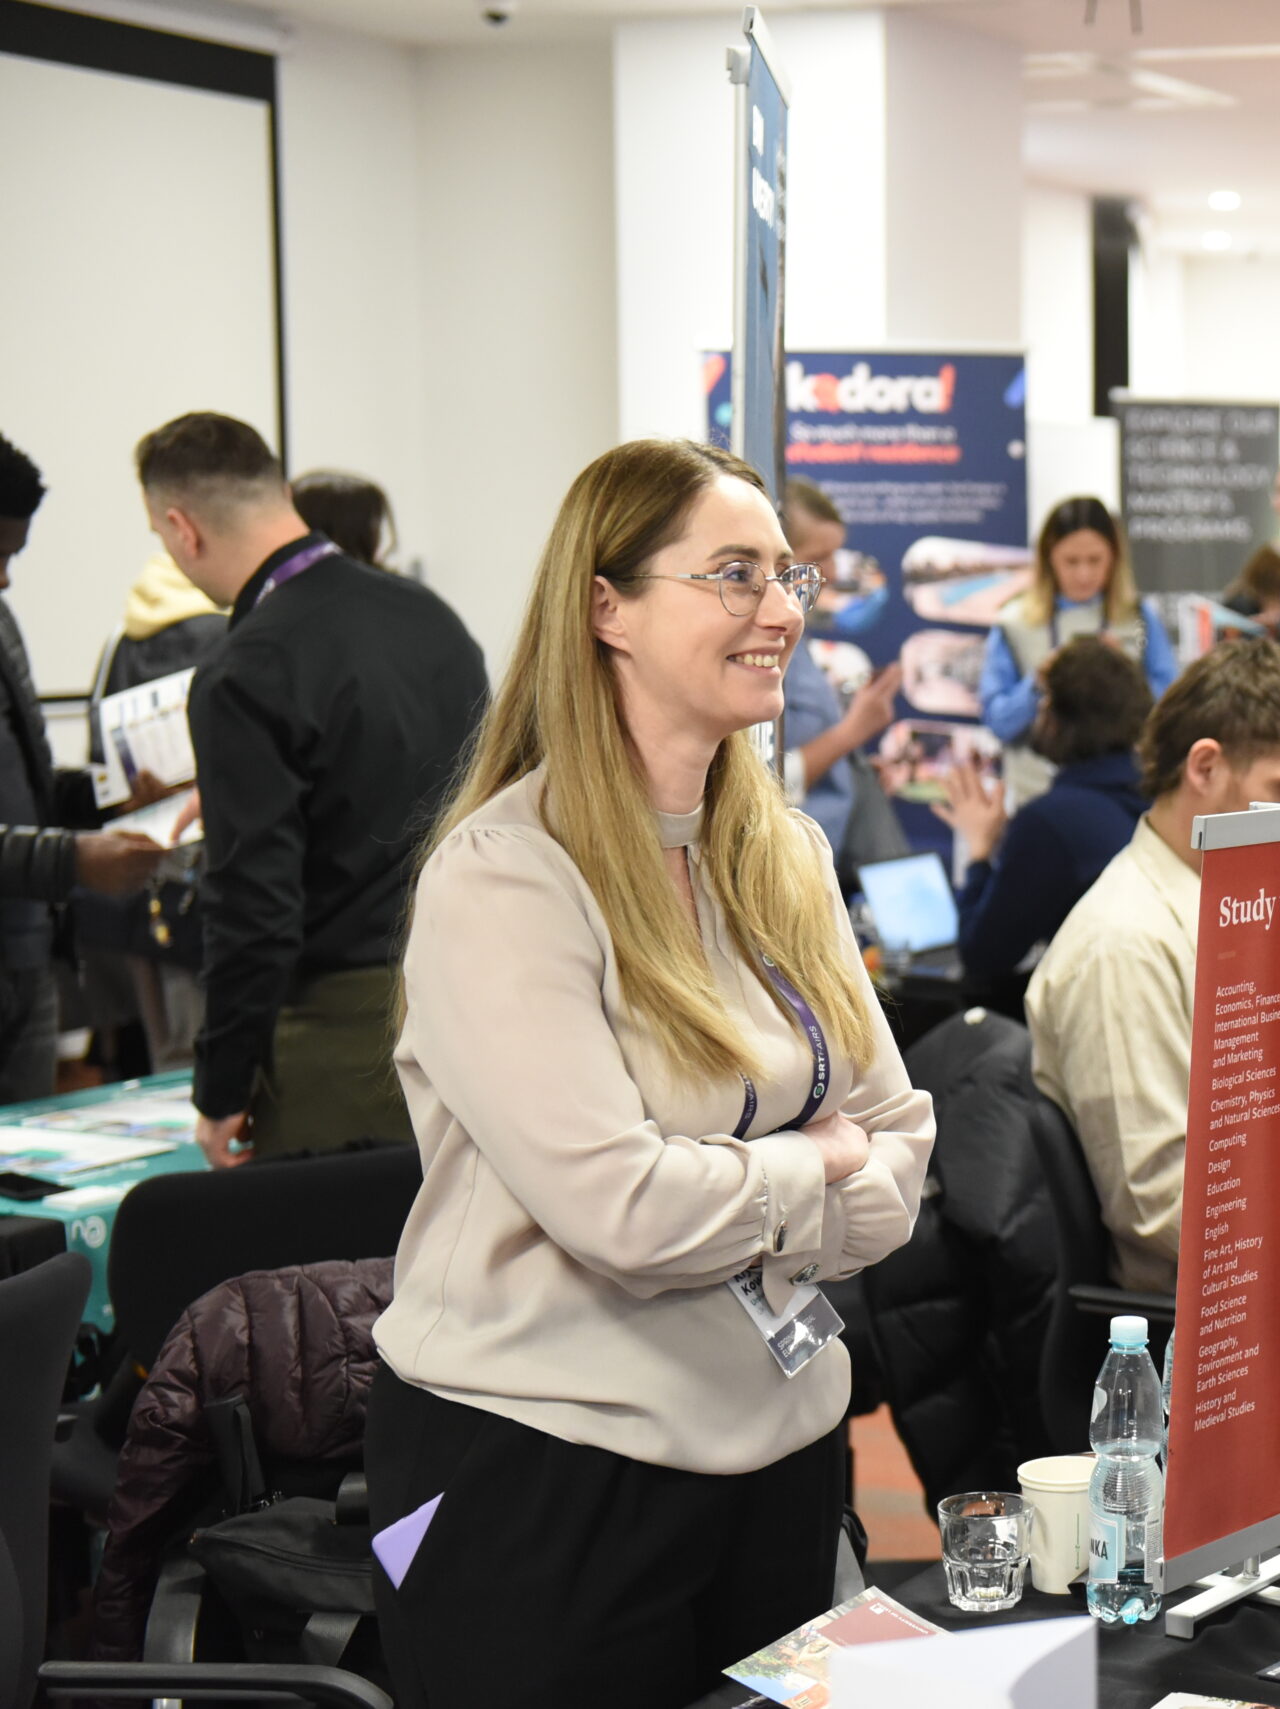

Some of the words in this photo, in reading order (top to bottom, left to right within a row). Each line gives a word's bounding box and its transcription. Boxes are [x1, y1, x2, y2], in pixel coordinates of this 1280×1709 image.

[1220, 887, 1277, 931] Study
[1216, 979, 1256, 998] Accounting,
[1216, 999, 1254, 1016] Economics,
[1215, 1012, 1259, 1033] International
[1214, 1031, 1259, 1051] Management
[1213, 1054, 1226, 1069] and
[1227, 1046, 1264, 1065] Marketing
[1212, 1070, 1245, 1091] Biological
[1246, 1066, 1276, 1082] Sciences
[1211, 1095, 1247, 1112] Chemistry,
[1249, 1087, 1275, 1104] Physics
[1210, 1115, 1223, 1130] and
[1224, 1108, 1251, 1126] Natural
[1252, 1103, 1280, 1119] Sciences
[1209, 1132, 1247, 1152] Computing
[1208, 1158, 1231, 1174] Design
[1207, 1176, 1241, 1196] Education
[1206, 1196, 1248, 1219] Engineering
[1205, 1221, 1229, 1241] English
[1204, 1248, 1219, 1262] Fine
[1220, 1243, 1233, 1256] Art,
[1235, 1236, 1263, 1251] History
[1203, 1264, 1211, 1279] of
[1212, 1263, 1223, 1276] Art
[1225, 1256, 1238, 1272] and
[1202, 1276, 1229, 1297] Cultural
[1230, 1269, 1258, 1287] Studies
[1201, 1300, 1219, 1318] Food
[1220, 1294, 1247, 1312] Science
[1200, 1320, 1213, 1336] and
[1214, 1311, 1247, 1331] Nutrition
[1199, 1335, 1239, 1358] Geography,
[1198, 1350, 1243, 1375] Environment
[1244, 1342, 1260, 1359] and
[1197, 1375, 1216, 1393] Earth
[1218, 1365, 1249, 1385] Sciences
[1196, 1396, 1222, 1414] History
[1223, 1387, 1237, 1404] and
[1195, 1408, 1226, 1432] Medieval
[1228, 1400, 1256, 1419] Studies
